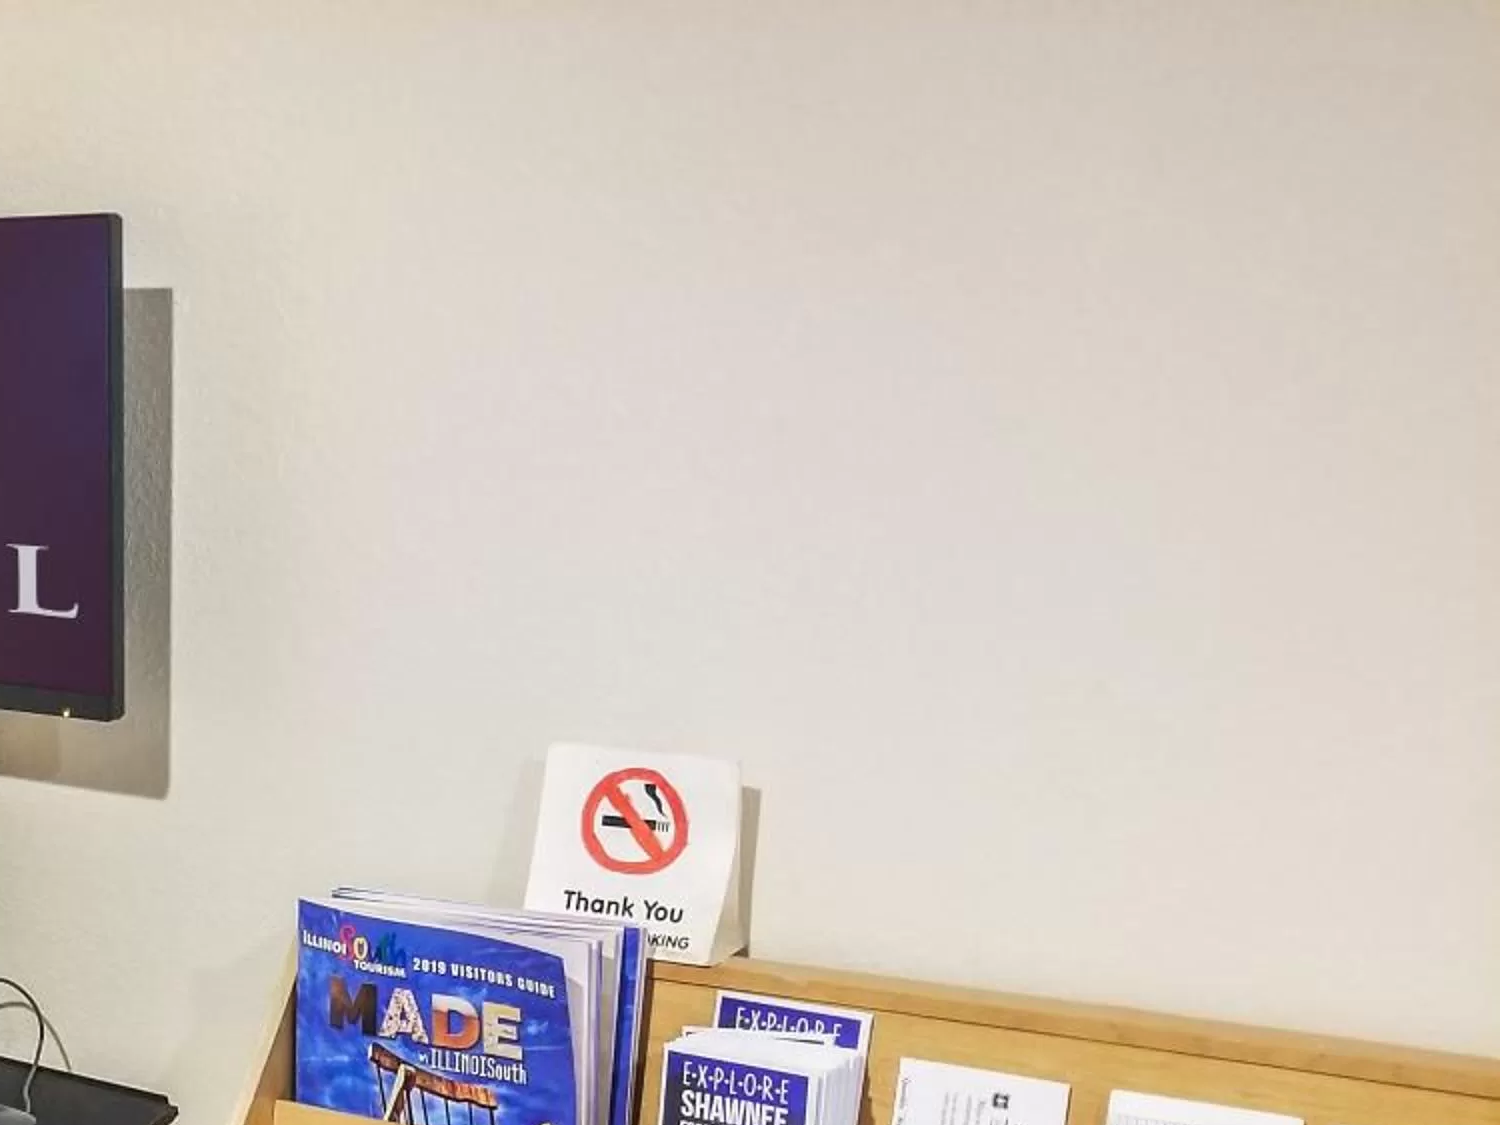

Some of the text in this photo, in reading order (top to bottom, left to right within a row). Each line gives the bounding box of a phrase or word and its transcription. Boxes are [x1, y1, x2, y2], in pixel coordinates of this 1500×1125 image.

[563, 889, 684, 923] Thank You
[354, 959, 407, 979] TOURISM
[412, 957, 556, 999] 2019 VISITORS GUIDE
[328, 975, 523, 1061] MADE
